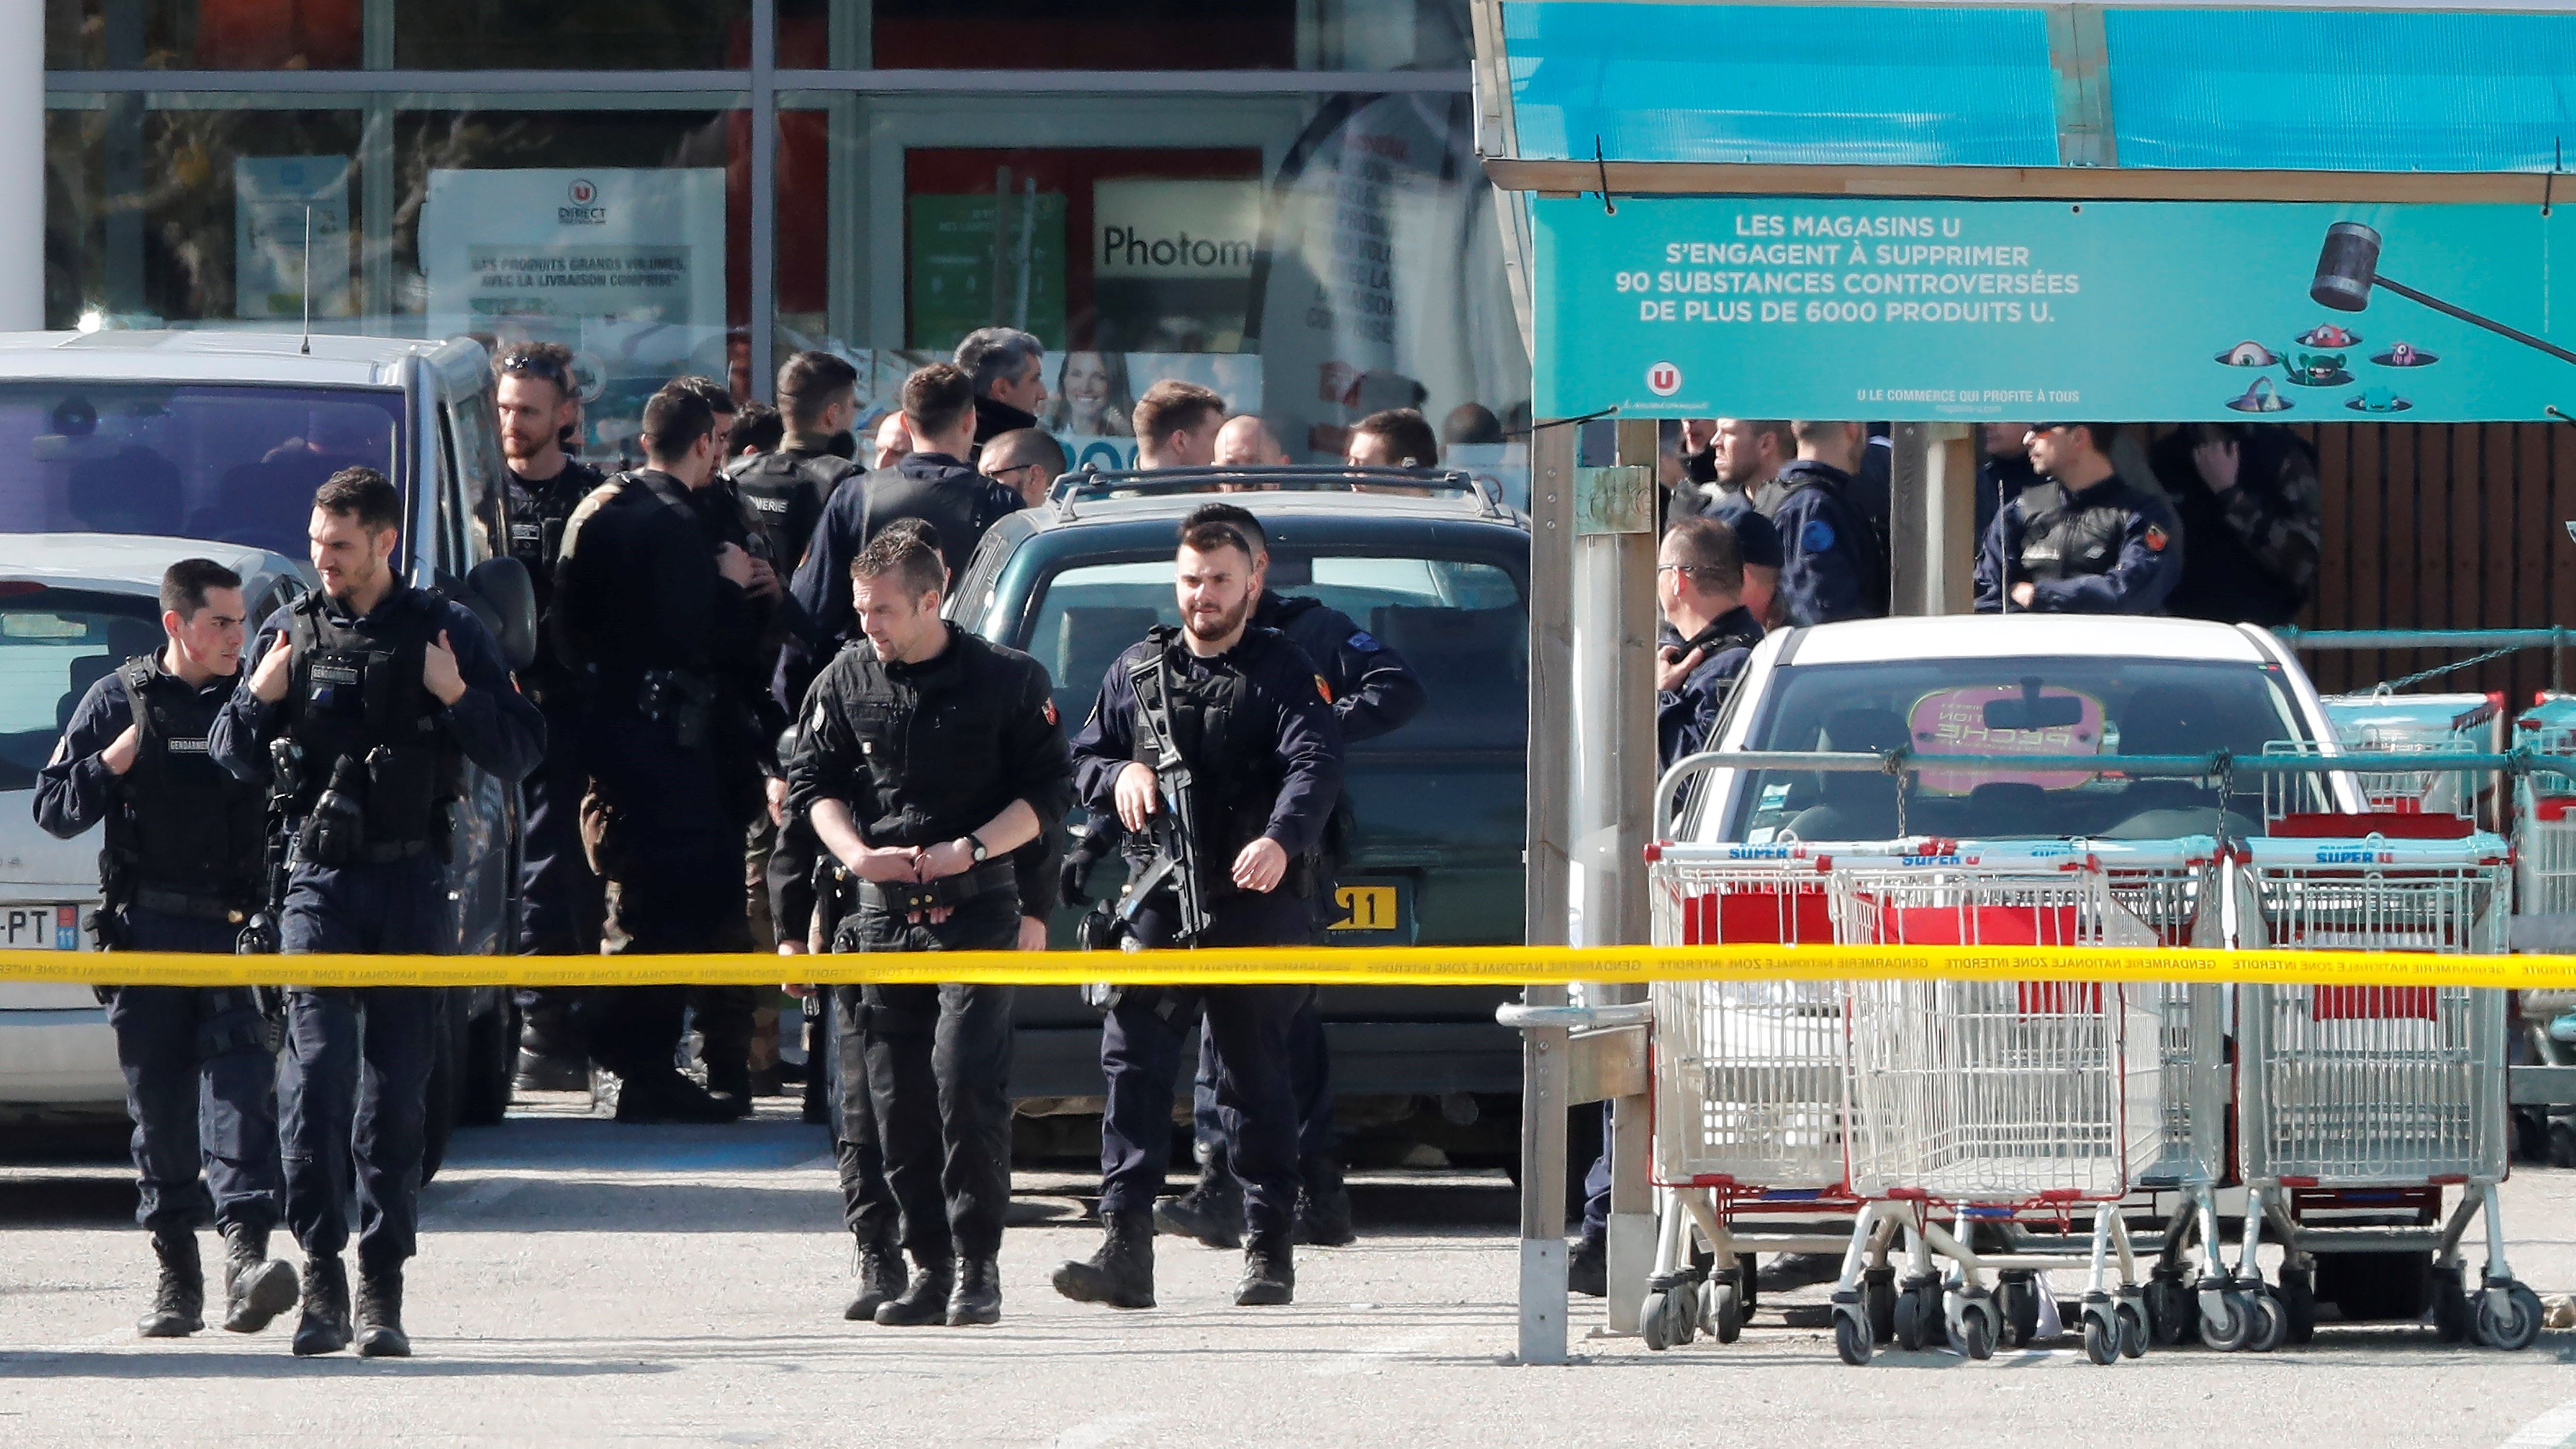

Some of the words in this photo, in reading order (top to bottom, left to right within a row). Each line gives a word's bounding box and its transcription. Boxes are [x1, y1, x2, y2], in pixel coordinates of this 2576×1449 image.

[557, 207, 606, 218] DIRECT
[1735, 215, 1785, 236] LES
[1793, 216, 1934, 237] MAGASINS
[1942, 218, 1960, 238] U
[1104, 226, 1253, 265] Photom
[1848, 241, 1867, 265] À
[1876, 244, 2029, 266] SUPPRIMER
[569, 258, 623, 272] GRANDS
[517, 275, 534, 288] LA
[539, 275, 606, 288] LIVRAISON
[1616, 272, 1649, 292] 90
[1658, 271, 1835, 293] SUBSTANCES
[1843, 269, 2080, 294] CONTROVERSÉES
[1640, 300, 1675, 321] DE
[1685, 301, 1752, 322] PLUS
[1761, 302, 1798, 322] DE
[1806, 301, 1877, 323] 6000
[1886, 302, 2022, 323] PRODUITS
[2030, 302, 2055, 323] U.
[1858, 390, 1866, 401] U
[1870, 390, 1883, 401] LE
[1887, 390, 1955, 402] COMMERCE
[1960, 391, 1979, 402] QUI
[1984, 391, 2032, 402] PROFITE
[2037, 389, 2045, 402] À
[2049, 391, 2079, 402] TOUS
[1729, 848, 1788, 859] SUPER
[1793, 848, 1806, 859] U
[2316, 851, 2373, 863] SUPER
[2378, 852, 2393, 863] U
[0, 911, 47, 943] -PT
